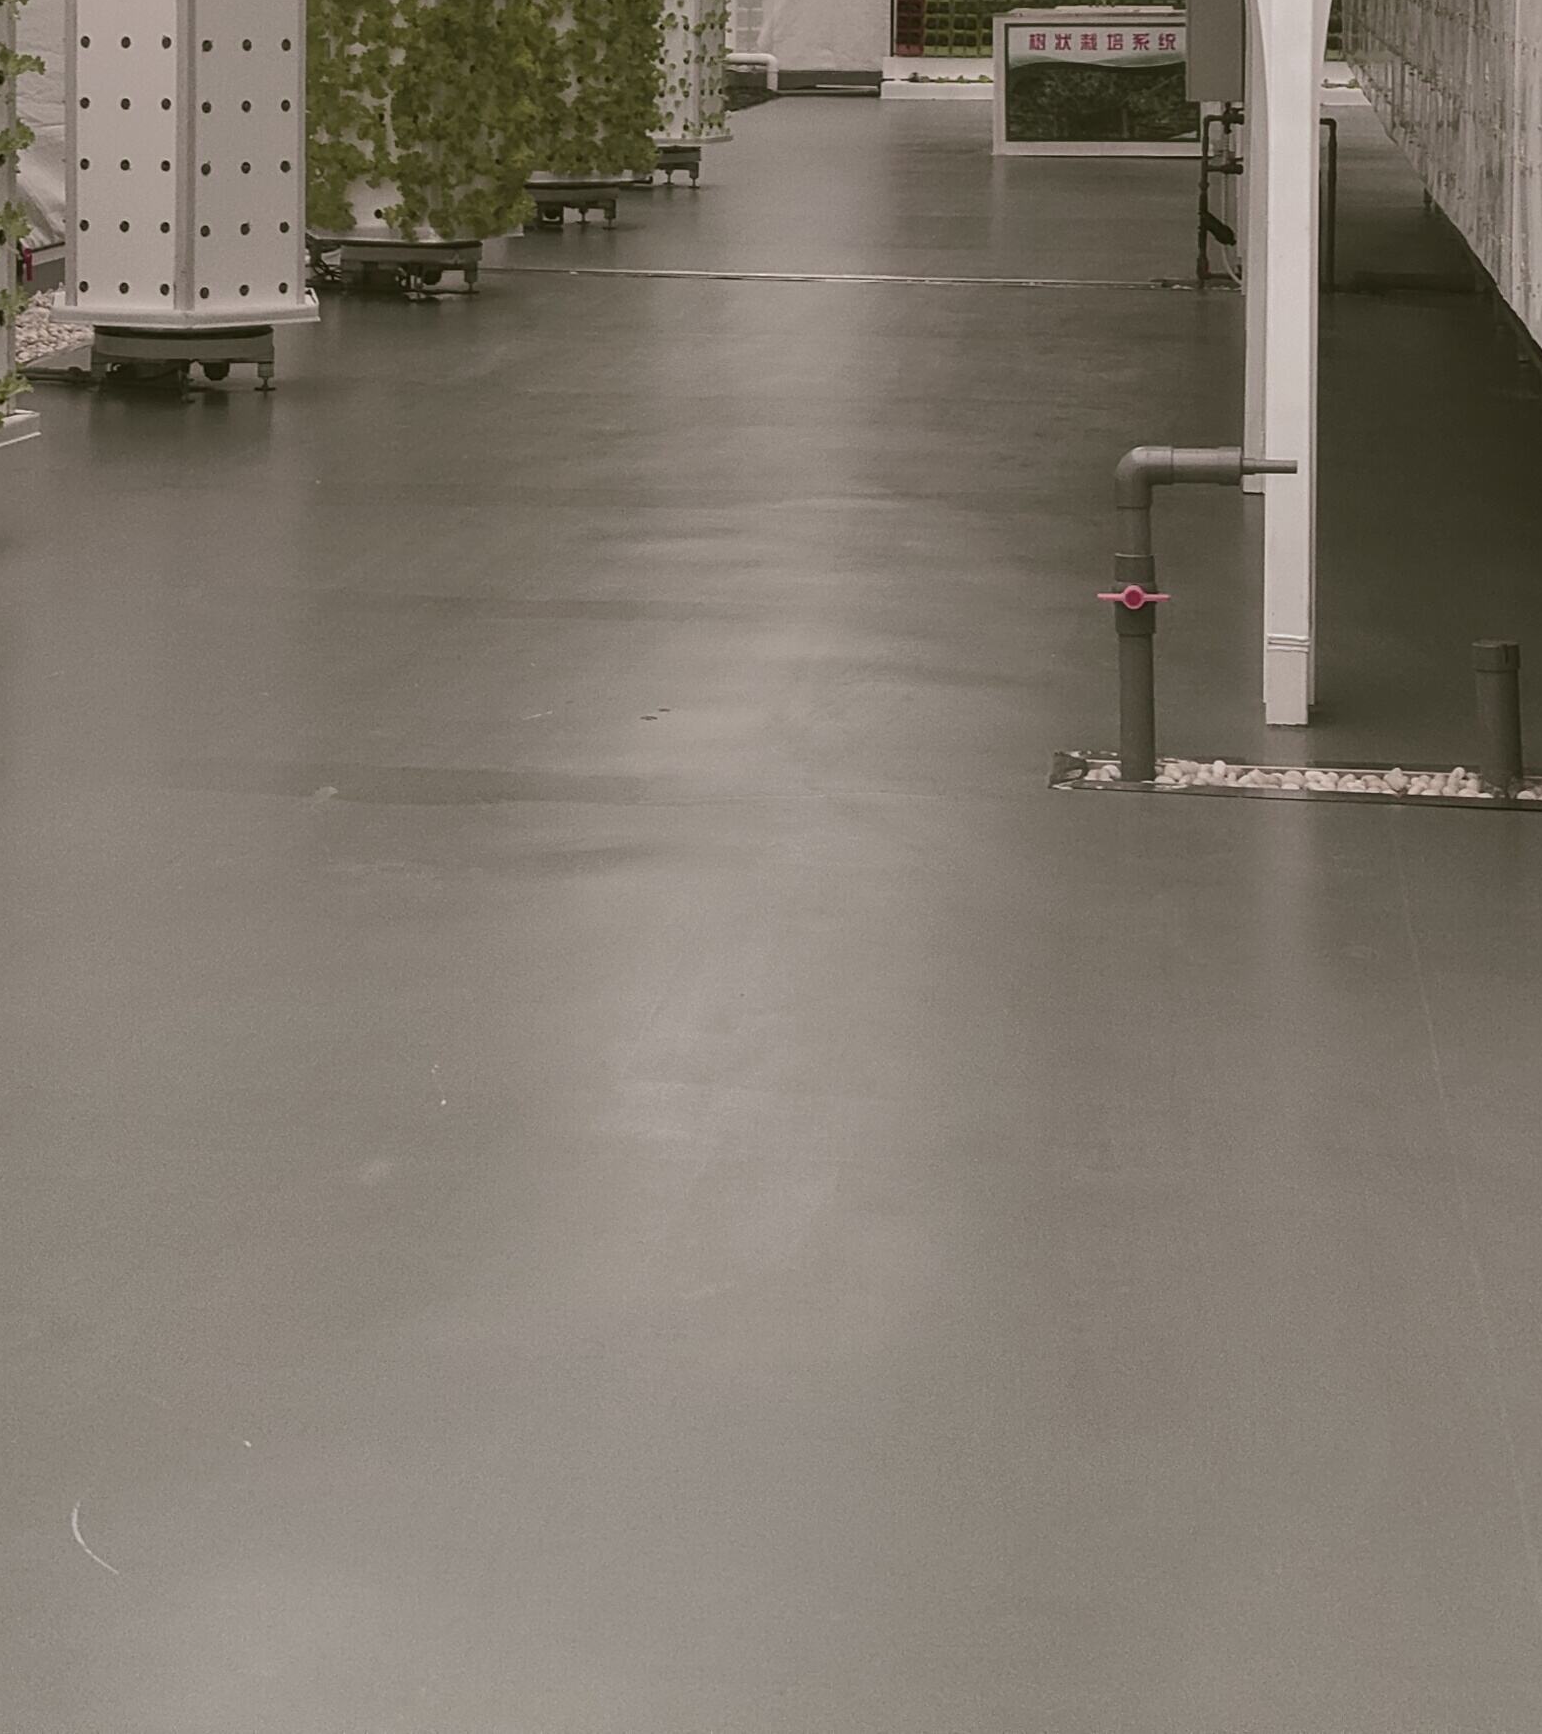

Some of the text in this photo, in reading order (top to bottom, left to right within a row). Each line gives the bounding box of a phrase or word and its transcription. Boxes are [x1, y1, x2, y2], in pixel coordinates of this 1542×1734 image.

[1028, 32, 1177, 52] 树状栽培系统
